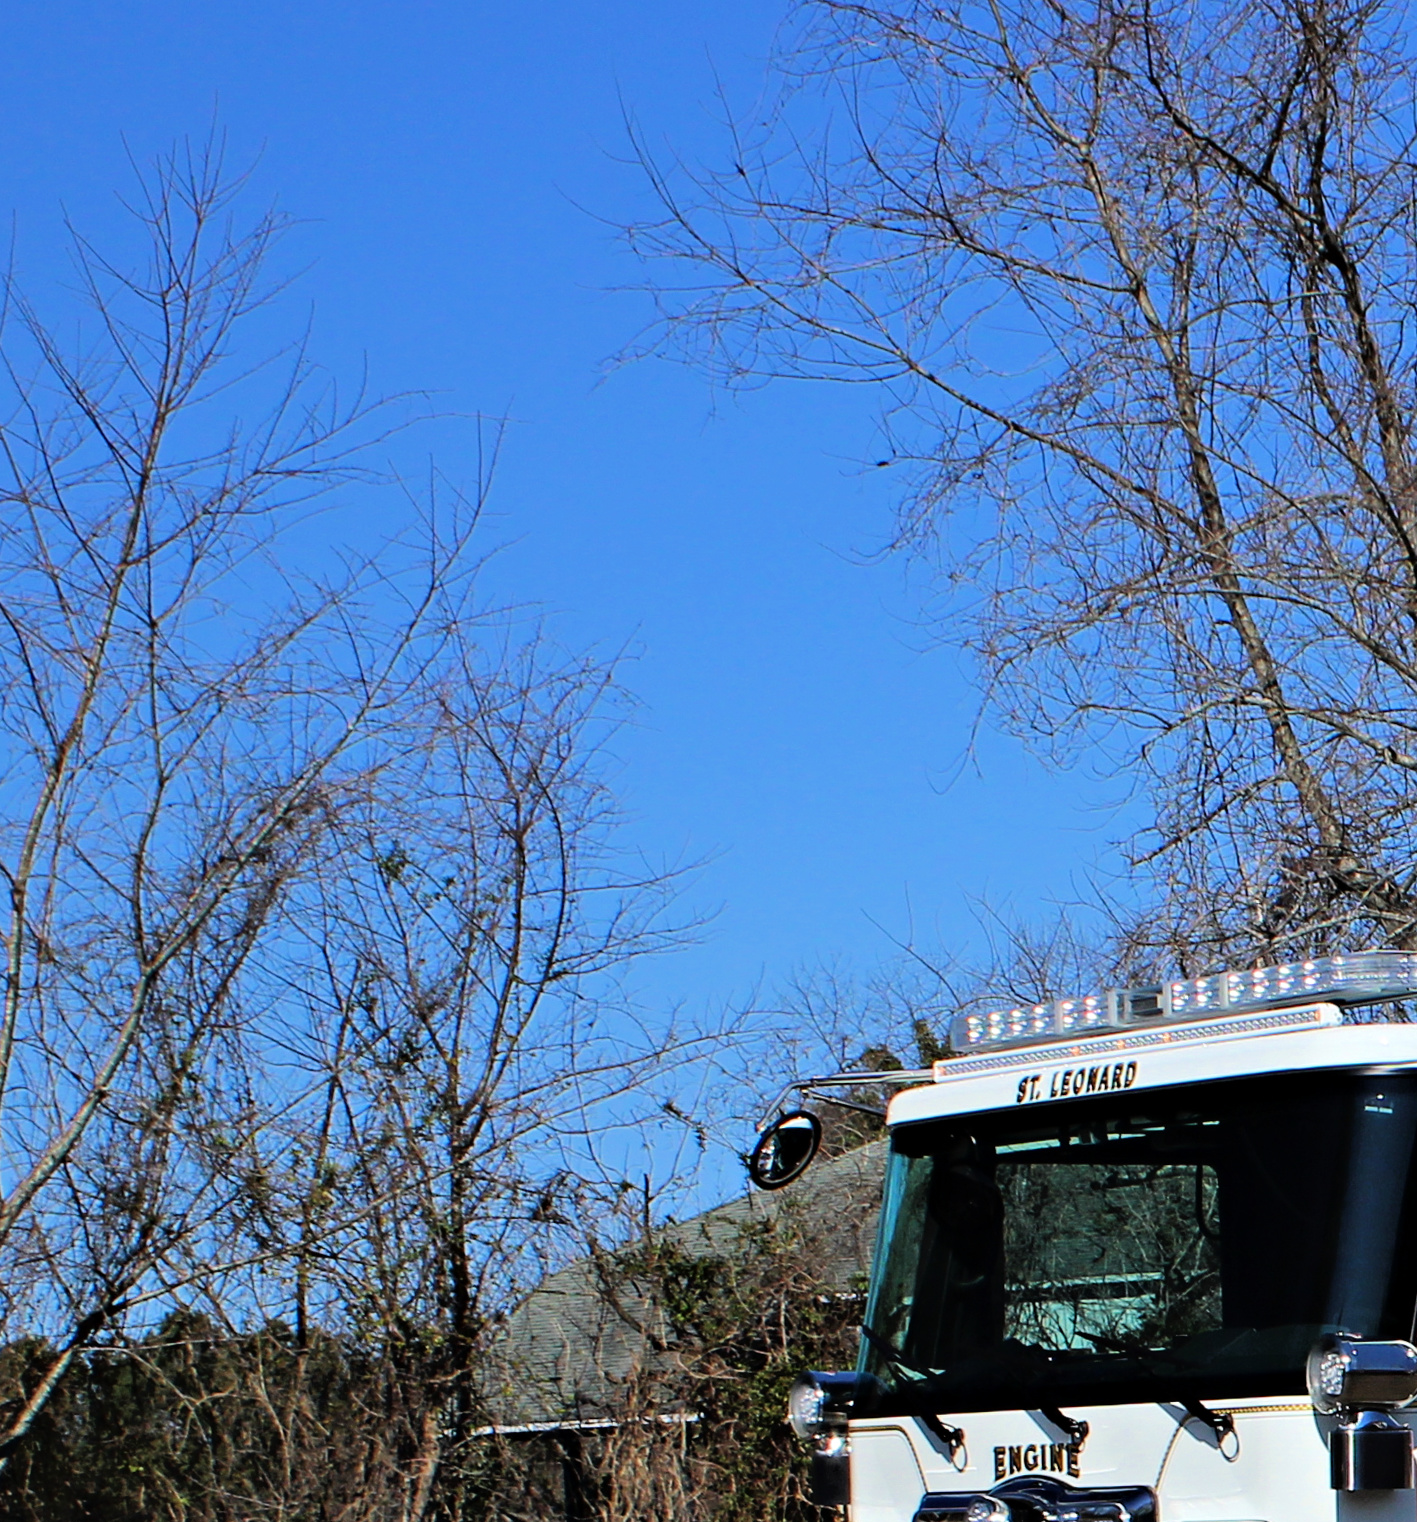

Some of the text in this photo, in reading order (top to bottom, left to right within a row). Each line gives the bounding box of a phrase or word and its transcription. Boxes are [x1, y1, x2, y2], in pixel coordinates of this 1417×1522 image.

[1016, 1061, 1138, 1103] ST. LEONARD
[993, 1443, 1081, 1482] ENGINE
